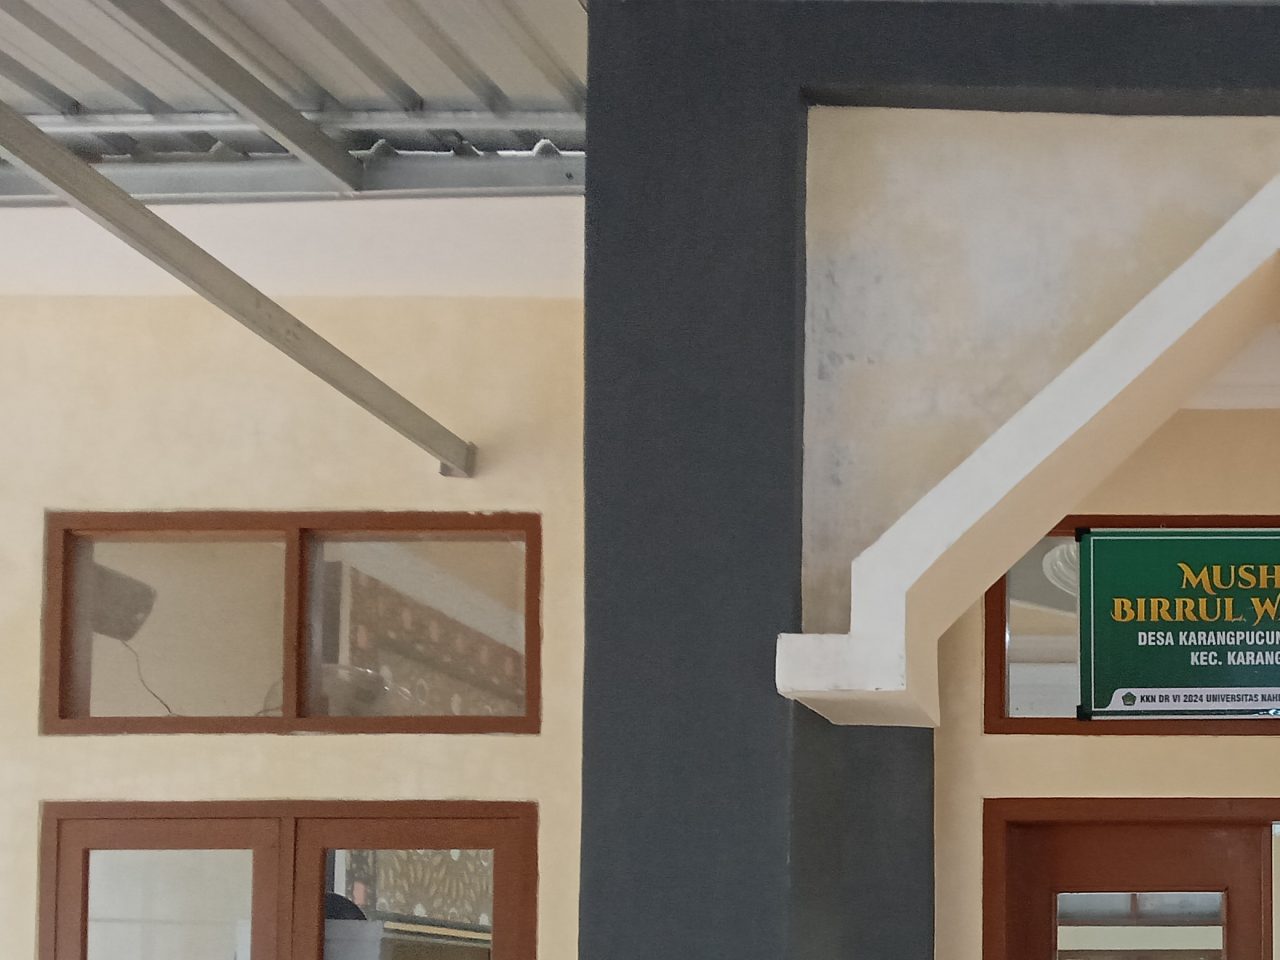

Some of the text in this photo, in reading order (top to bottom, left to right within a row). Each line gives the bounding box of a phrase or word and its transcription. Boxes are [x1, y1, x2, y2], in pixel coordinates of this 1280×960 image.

[1110, 597, 1243, 623] BIRRUL
[1138, 631, 1175, 646] DESA
[1190, 651, 1223, 666] KEC.
[1140, 694, 1156, 703] KKN
[1159, 694, 1170, 703] DR
[1172, 694, 1181, 703] VI
[1183, 694, 1203, 703] 2024
[1206, 693, 1259, 703] UNIVERSITAS
